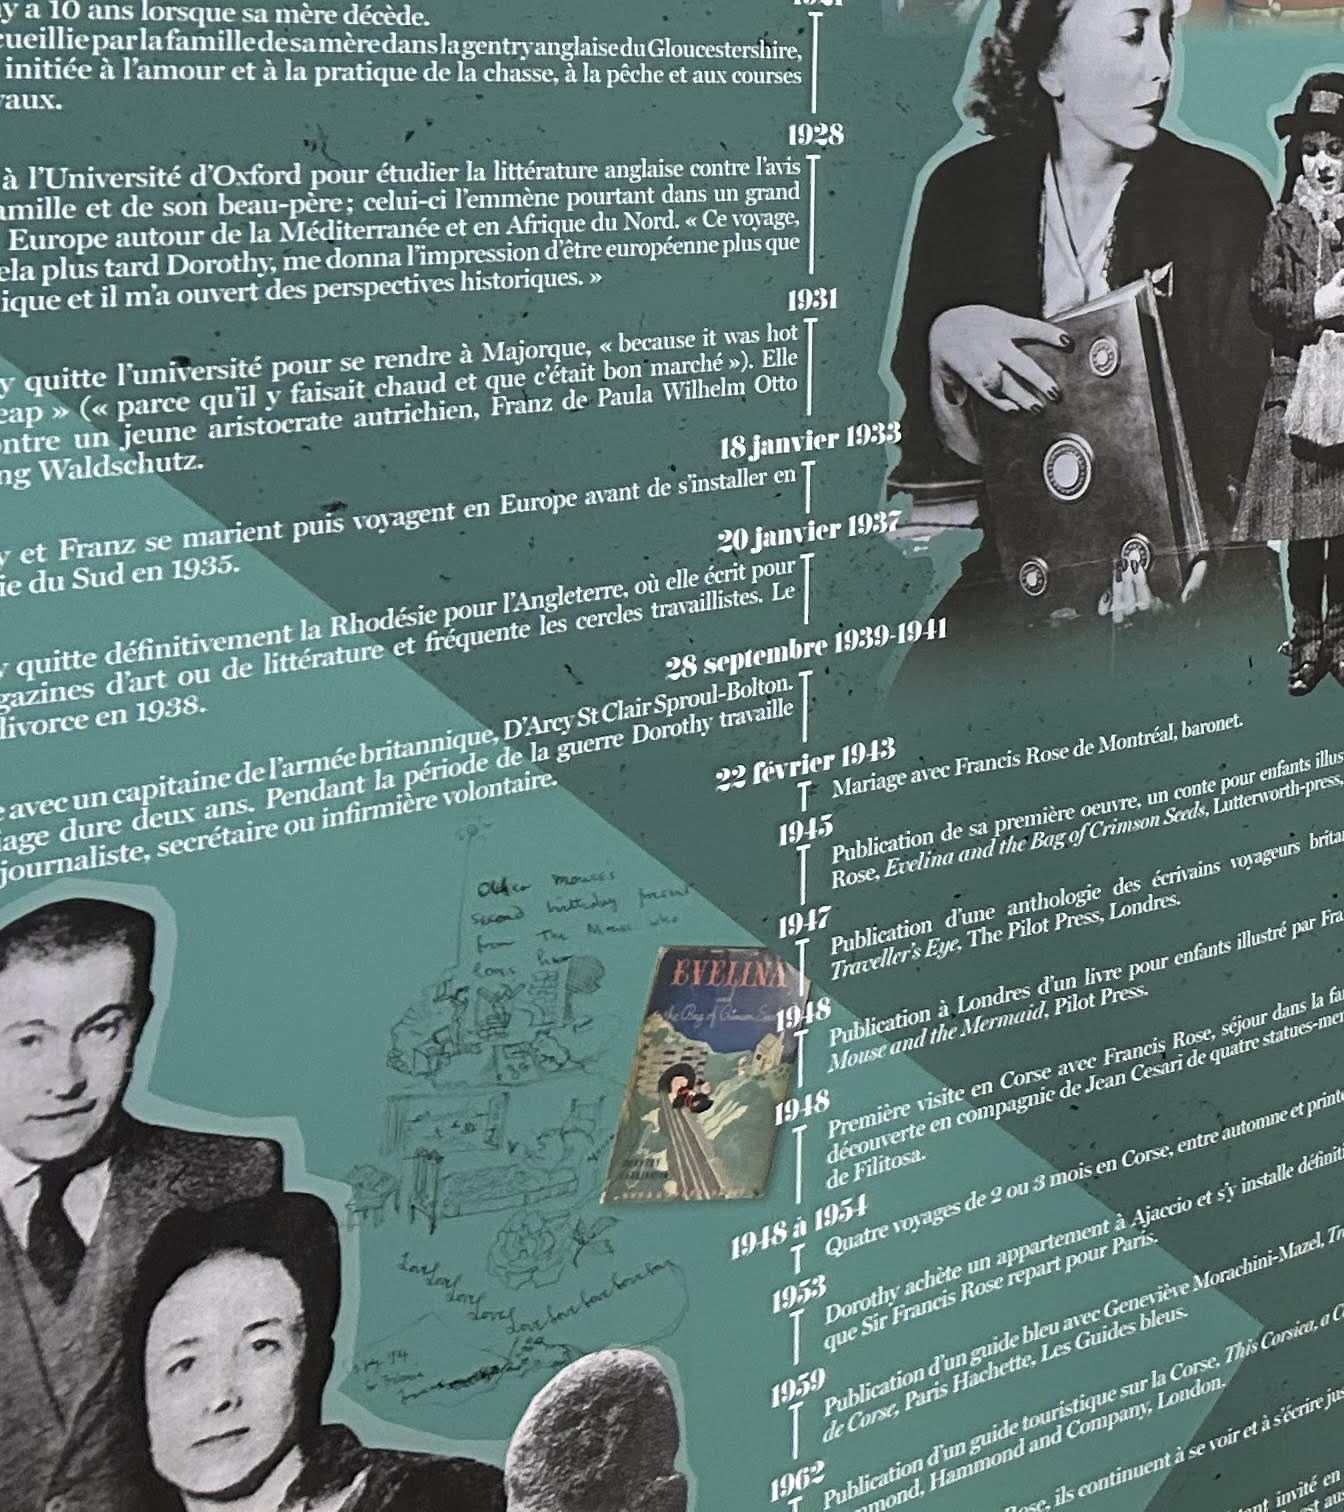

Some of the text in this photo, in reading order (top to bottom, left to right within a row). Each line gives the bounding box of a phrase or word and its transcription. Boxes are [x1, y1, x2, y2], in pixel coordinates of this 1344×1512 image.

[24, 2, 43, 20] a
[47, 0, 81, 20] 10
[87, 3, 135, 21] ans
[241, 7, 270, 24] sa
[274, 1, 338, 25] mère
[342, 3, 431, 27] décède.
[789, 122, 845, 146] 1928
[788, 287, 837, 312] 1931
[721, 421, 902, 462] 18 janvier 1933
[37, 450, 205, 481] Waldschutz.
[19, 543, 47, 565] et
[58, 537, 137, 561] Franz
[144, 535, 173, 553] se
[182, 520, 284, 549] marient
[292, 511, 345, 544] puis
[351, 502, 457, 531] voyagent
[462, 501, 491, 519] en
[499, 492, 578, 515] Europe
[584, 482, 641, 506] avant
[646, 476, 673, 498] de
[773, 468, 797, 484] en
[718, 510, 903, 554] 20 janvier 1937
[28, 554, 241, 595] du Sud en 1935.
[665, 617, 946, 681] 28 septembre 1939-1941
[715, 736, 896, 792] 22 février 1943
[831, 771, 908, 799] Mariage
[910, 764, 952, 784] avec
[954, 749, 1022, 777] Francis
[1025, 746, 1070, 766] Rose
[1071, 737, 1096, 758] de
[156, 820, 279, 858] secrétaire
[283, 816, 316, 836] ou
[321, 791, 439, 829] infirmière
[442, 770, 558, 806] volontaire.
[779, 813, 834, 846] 1945
[779, 905, 832, 939] 1947
[966, 923, 1004, 948] The
[1006, 917, 1051, 941] Pilot
[671, 959, 788, 988] EVELINA
[776, 996, 832, 1033] 1948
[827, 1044, 888, 1074] Mouse
[889, 1027, 929, 1056] and
[929, 1022, 959, 1045] the
[1053, 992, 1097, 1016] Pilot
[775, 1089, 831, 1126] 1948
[825, 1167, 850, 1191] de
[731, 1193, 868, 1260] 1948 à 1954
[773, 1274, 827, 1314] 1953
[823, 1326, 858, 1354] que
[860, 1312, 889, 1337] Sir
[891, 1288, 957, 1326] Francis
[960, 1276, 1004, 1302] Rose
[1007, 1255, 1062, 1287] repart
[1064, 1245, 1109, 1274] pour
[771, 1367, 826, 1408] 1959
[822, 1419, 845, 1443] de
[904, 1380, 949, 1412] Paris
[1040, 1341, 1072, 1362] Les
[1074, 1320, 1137, 1350] Guides
[771, 1460, 825, 1502] 1962
